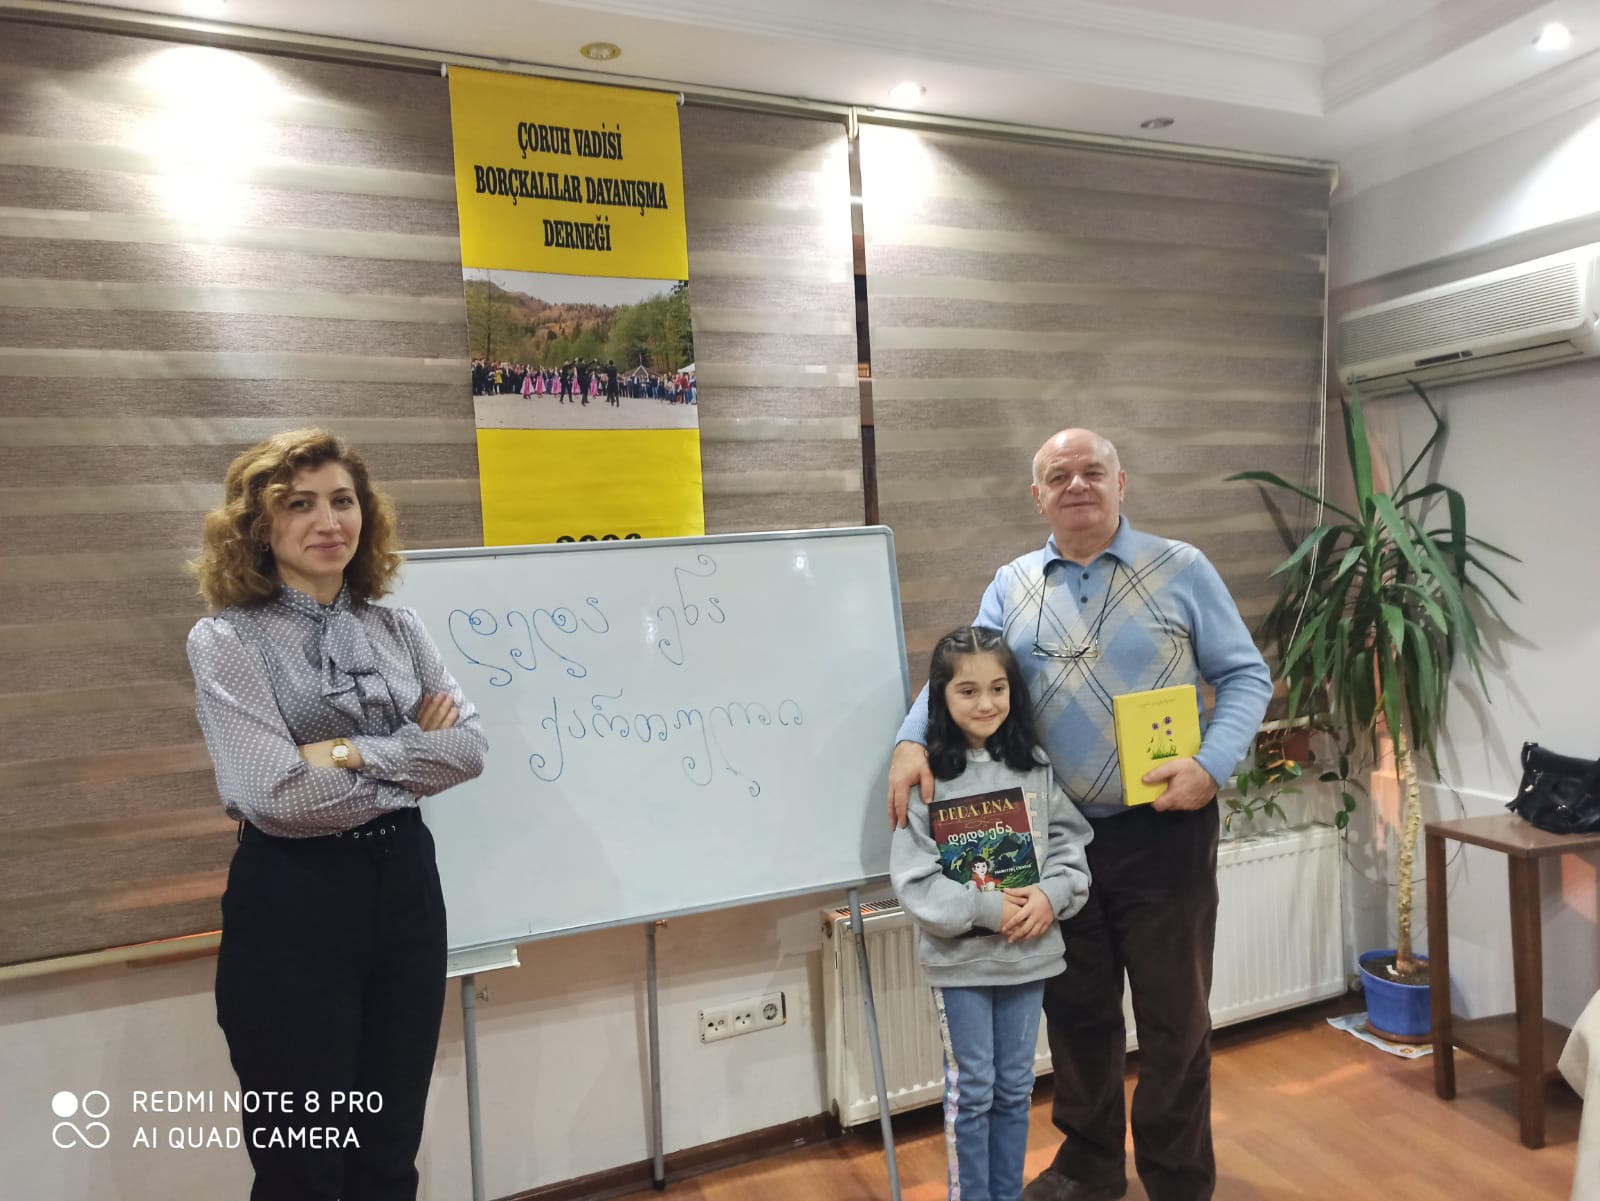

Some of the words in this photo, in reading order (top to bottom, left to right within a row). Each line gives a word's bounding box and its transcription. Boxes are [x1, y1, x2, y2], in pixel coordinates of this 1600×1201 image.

[518, 122, 571, 159] ÇORUH
[573, 123, 623, 160] VADİSİ
[474, 165, 582, 205] BORÇKALILAR
[586, 177, 668, 216] DAYANIŞMA
[543, 215, 612, 251] DERNEĞİ
[448, 596, 609, 687] დედა
[656, 553, 726, 666] ენა
[529, 688, 803, 798] ქართული
[938, 803, 979, 822] DEDA
[982, 798, 1015, 815] ENA
[947, 829, 985, 846] დედა
[988, 821, 1013, 840] ენა
